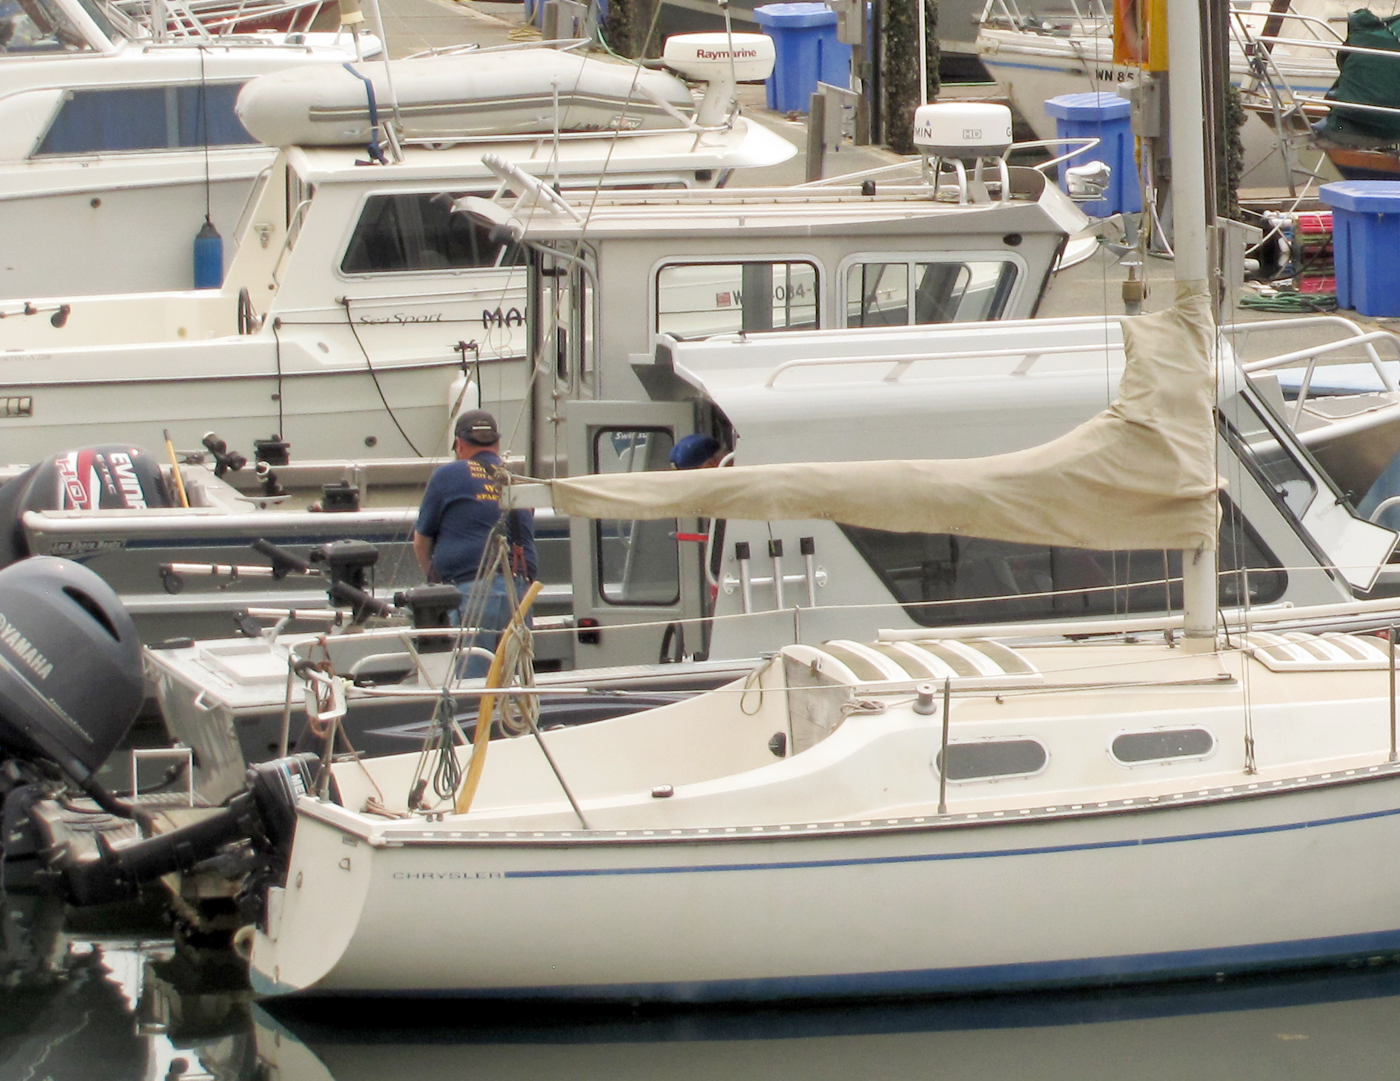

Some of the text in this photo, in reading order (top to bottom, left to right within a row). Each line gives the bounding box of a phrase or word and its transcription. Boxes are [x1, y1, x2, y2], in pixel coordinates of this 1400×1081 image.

[696, 47, 757, 60] Raymarine
[1095, 69, 1113, 81] WN
[963, 129, 982, 139] HD
[1, 622, 54, 680] YAMAHA
[392, 871, 501, 879] CHRYSLER
